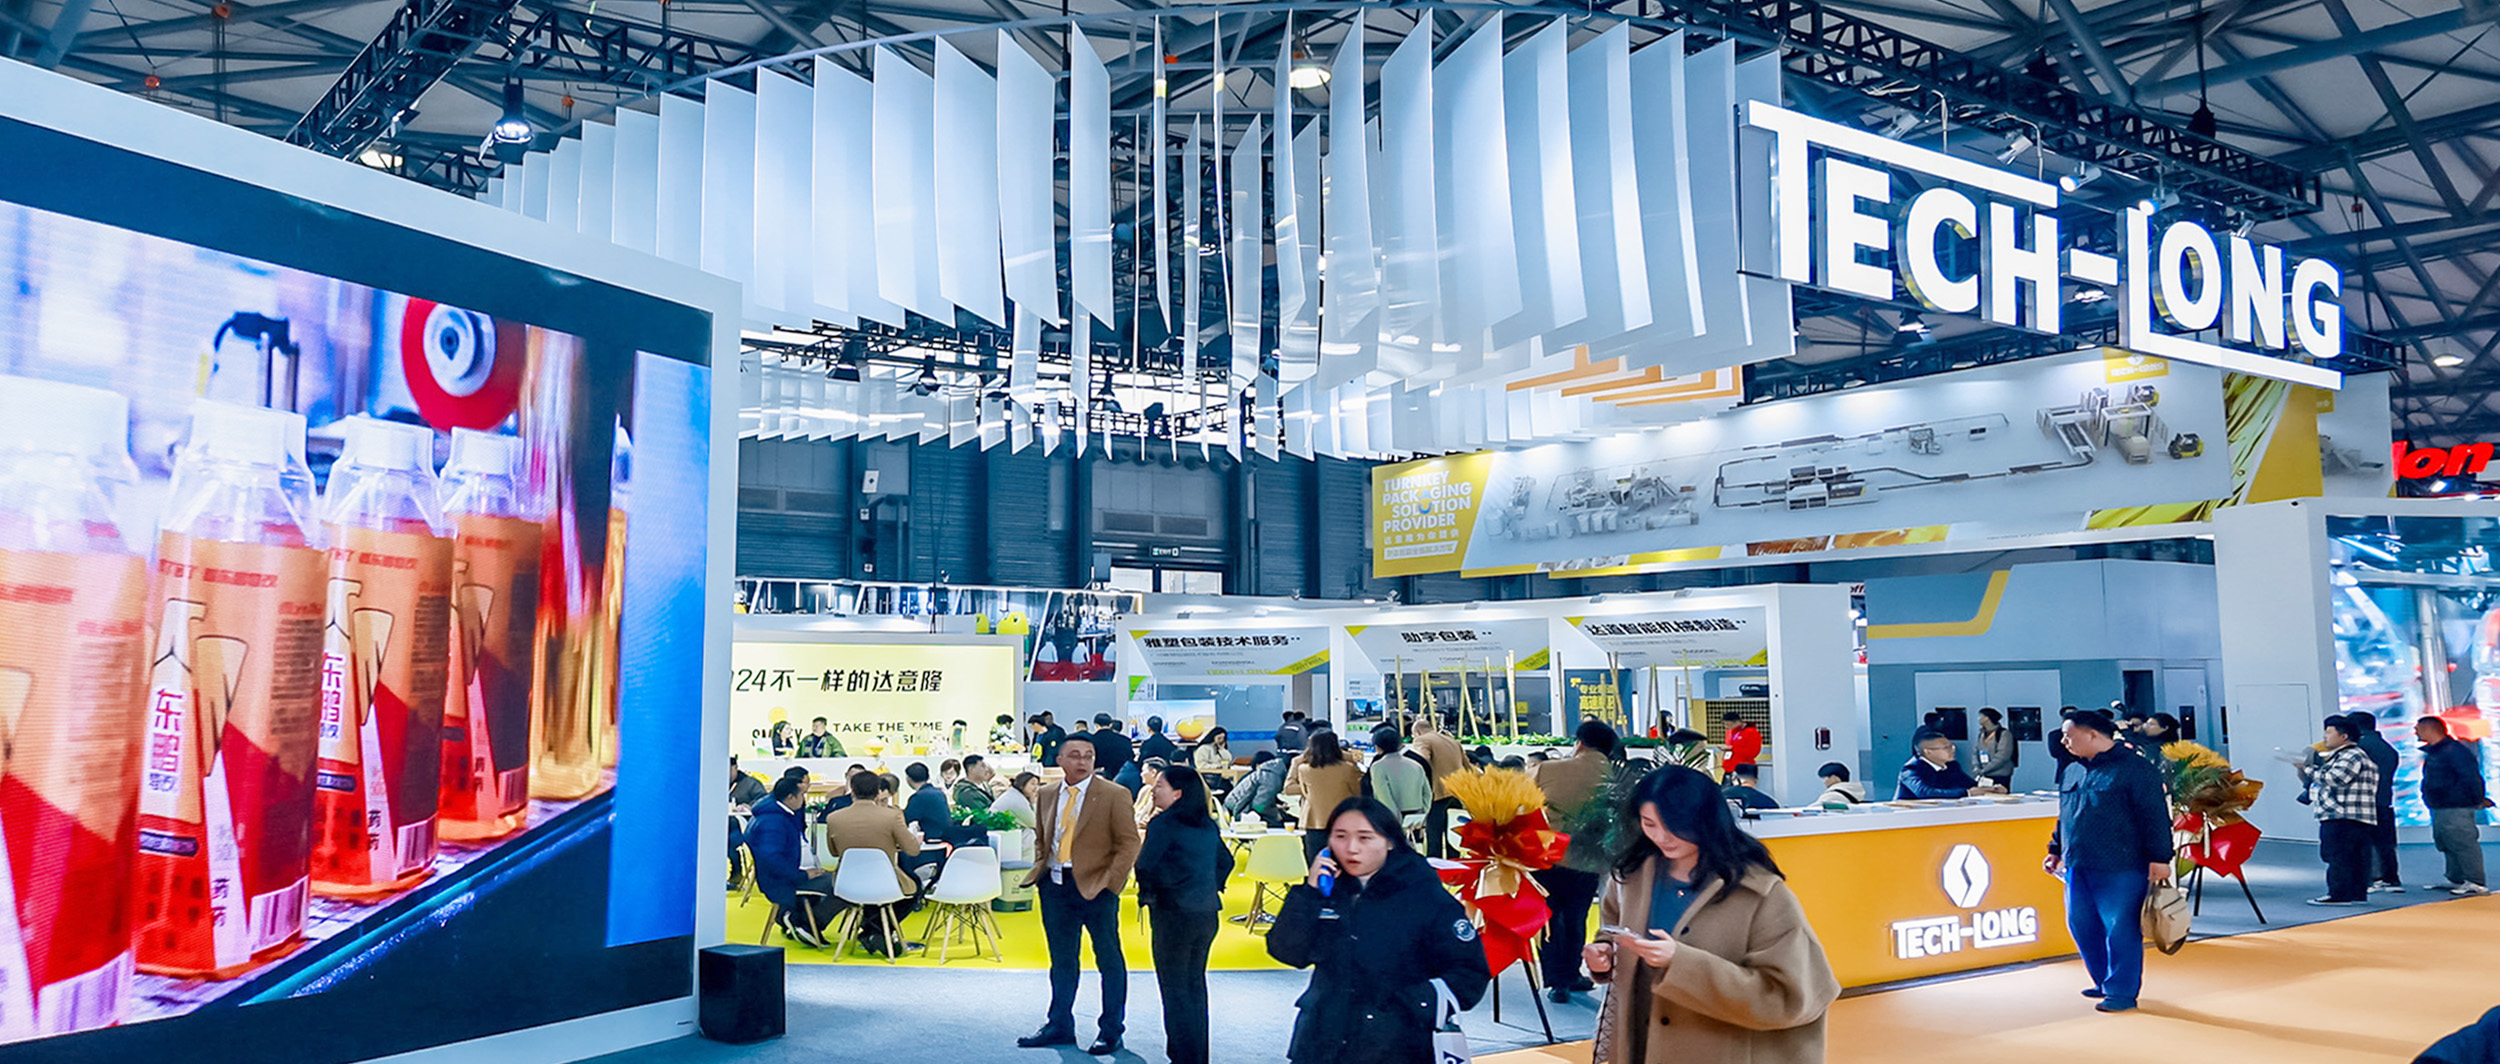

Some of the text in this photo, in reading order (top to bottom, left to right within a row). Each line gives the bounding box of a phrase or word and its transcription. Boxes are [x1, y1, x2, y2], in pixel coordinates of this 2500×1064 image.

[1746, 98, 2345, 391] TECH-LONG
[1383, 470, 1450, 492] TURNKEY
[1382, 481, 1473, 506] PACKAGING
[1391, 496, 1472, 519] SOLUTION
[1383, 513, 1456, 533] PROVIDER
[1585, 618, 1739, 636] 达道智能机械制造
[1144, 635, 1290, 648] 雅塑包装技术服务
[731, 668, 943, 692] 24不一样的达意隆
[833, 722, 872, 733] TAKE
[877, 722, 905, 732] THE
[1891, 906, 2037, 960] TECH-LONG
